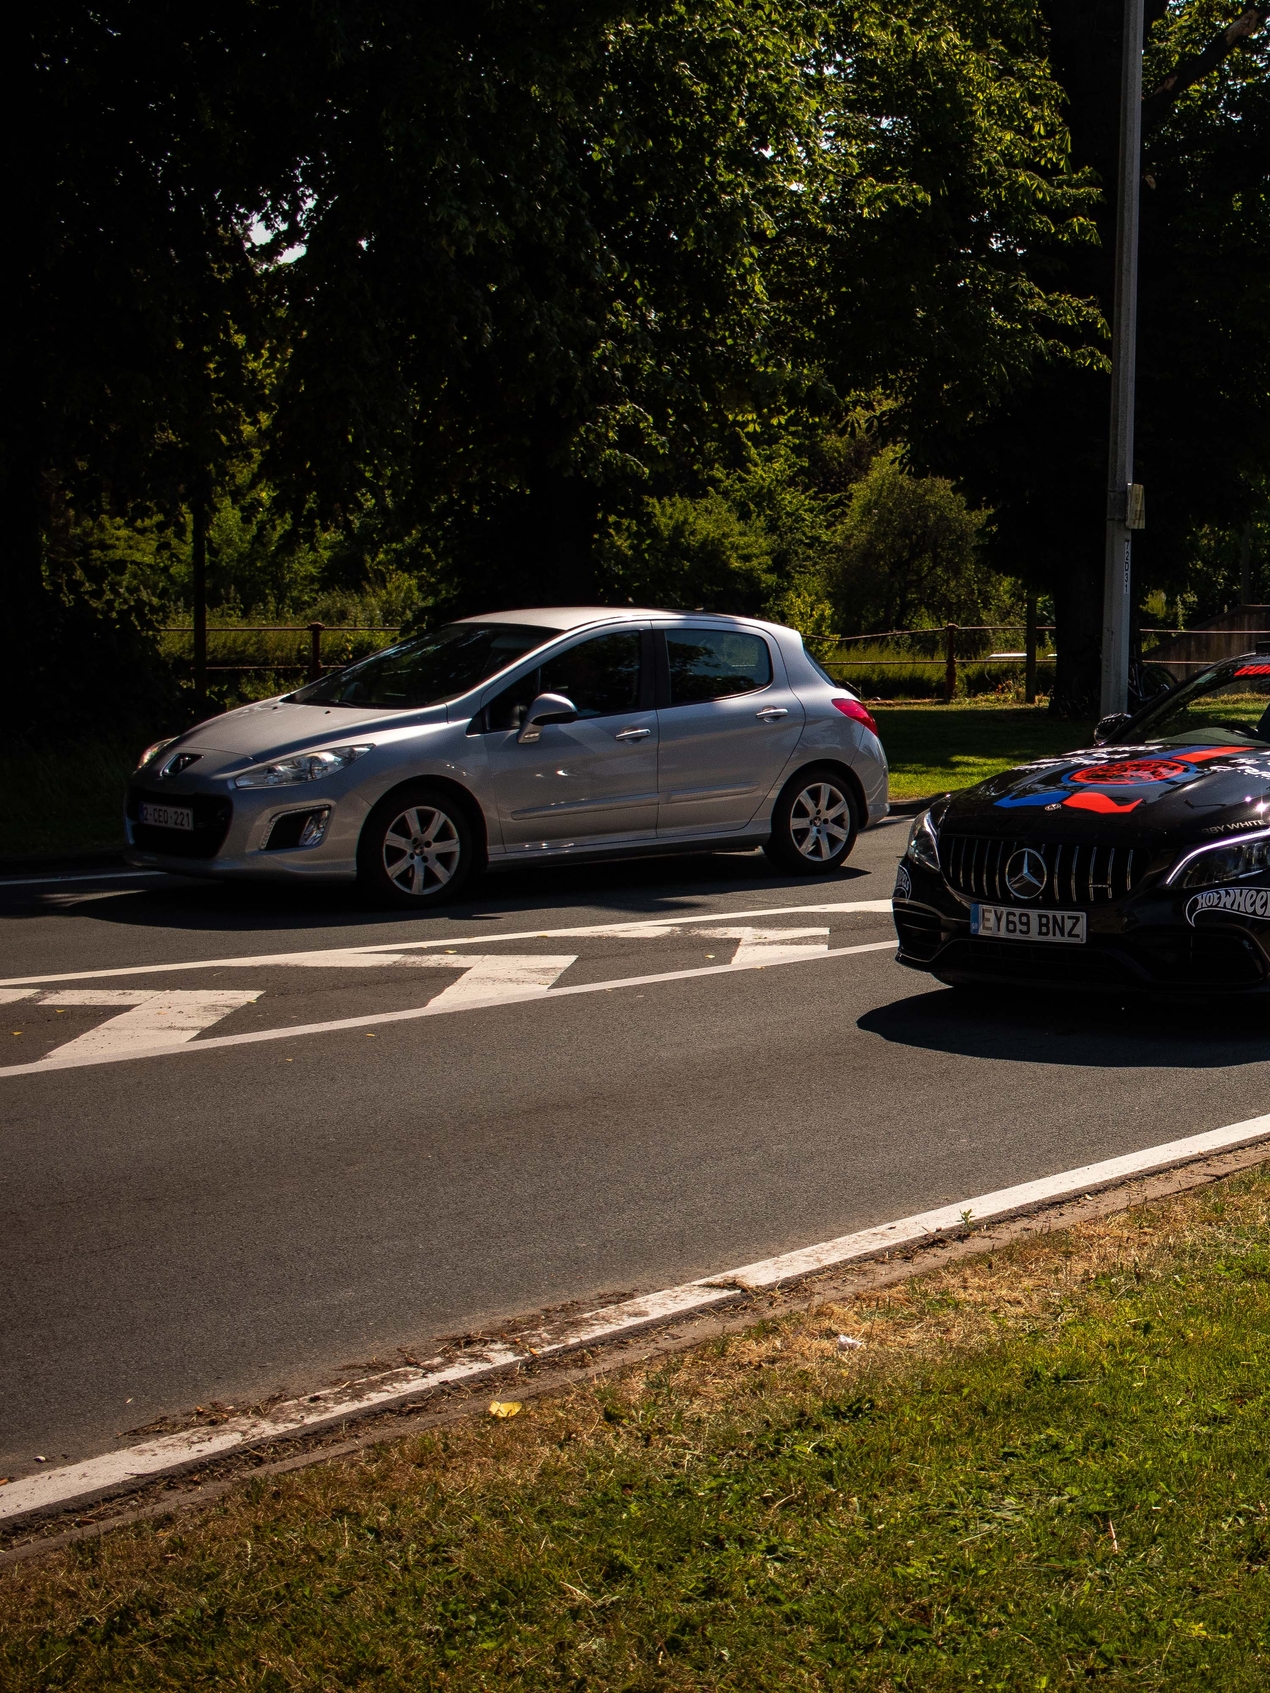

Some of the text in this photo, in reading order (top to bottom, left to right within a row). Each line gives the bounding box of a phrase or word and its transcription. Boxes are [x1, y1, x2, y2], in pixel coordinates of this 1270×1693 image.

[1226, 819, 1266, 831] WHITE
[981, 907, 1081, 939] EY69 BNZ
